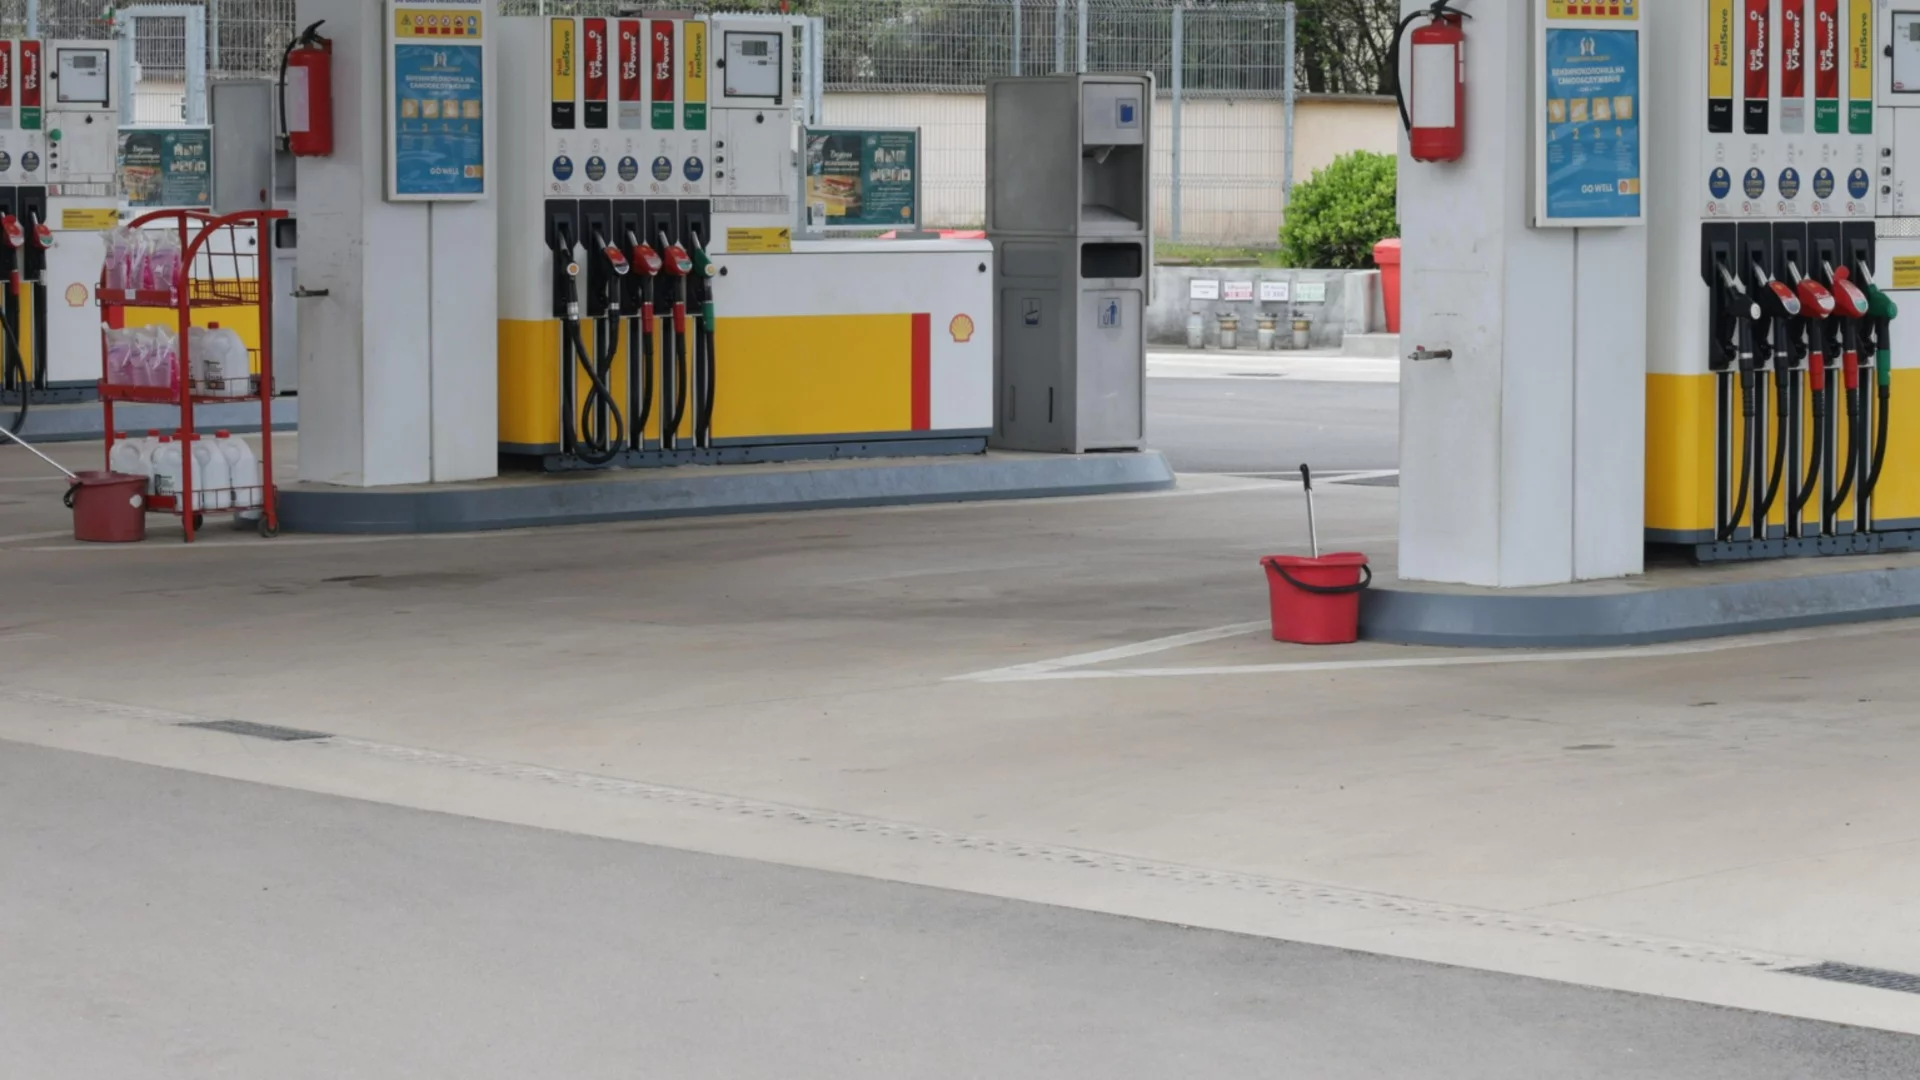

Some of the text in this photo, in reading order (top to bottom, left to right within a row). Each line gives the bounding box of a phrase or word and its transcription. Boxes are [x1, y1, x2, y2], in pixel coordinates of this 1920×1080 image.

[562, 30, 570, 76] FuelSave
[594, 34, 602, 77] V-Power
[661, 36, 669, 79] V-Power
[1720, 8, 1728, 67] FuelSave
[1755, 14, 1764, 70] V-Power
[1791, 14, 1800, 70] V-Power
[1825, 15, 1834, 71] V-Power
[1860, 12, 1868, 69] FuelSave
[1573, 128, 1579, 139] 2
[1594, 127, 1600, 138] 3
[1581, 183, 1613, 193] GO WELL
